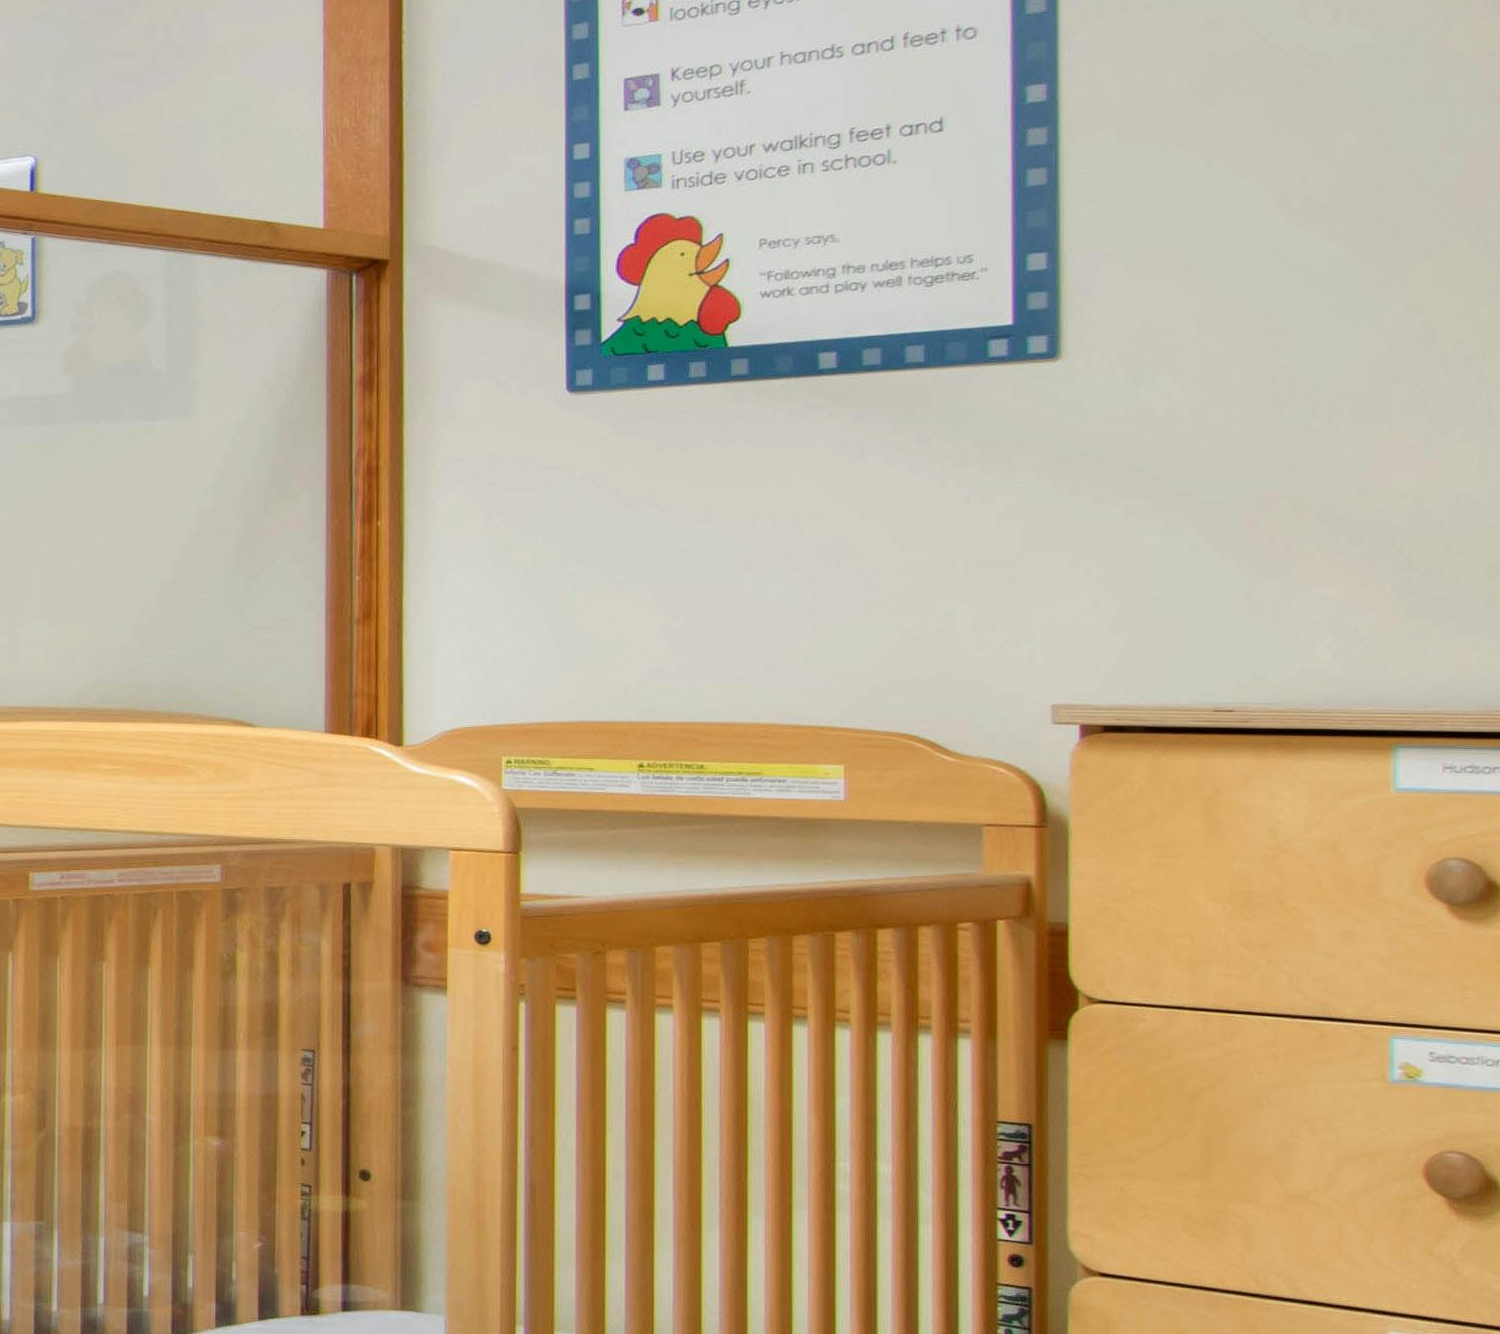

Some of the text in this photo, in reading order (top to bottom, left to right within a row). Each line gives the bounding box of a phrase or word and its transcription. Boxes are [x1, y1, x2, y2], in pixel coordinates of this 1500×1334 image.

[669, 0, 741, 21] looking
[670, 24, 978, 81] Keep your hands and feet to
[670, 79, 752, 107] yourself.
[671, 116, 944, 166] Use your walking feet and
[671, 148, 897, 190] inside voice in school.
[758, 237, 799, 250] Percy
[842, 264, 866, 275] the
[870, 259, 906, 273] rules
[910, 255, 952, 270] helps
[956, 253, 974, 266] us
[759, 287, 794, 300] work
[799, 283, 830, 297] and
[834, 280, 868, 295] play
[873, 275, 902, 289] well
